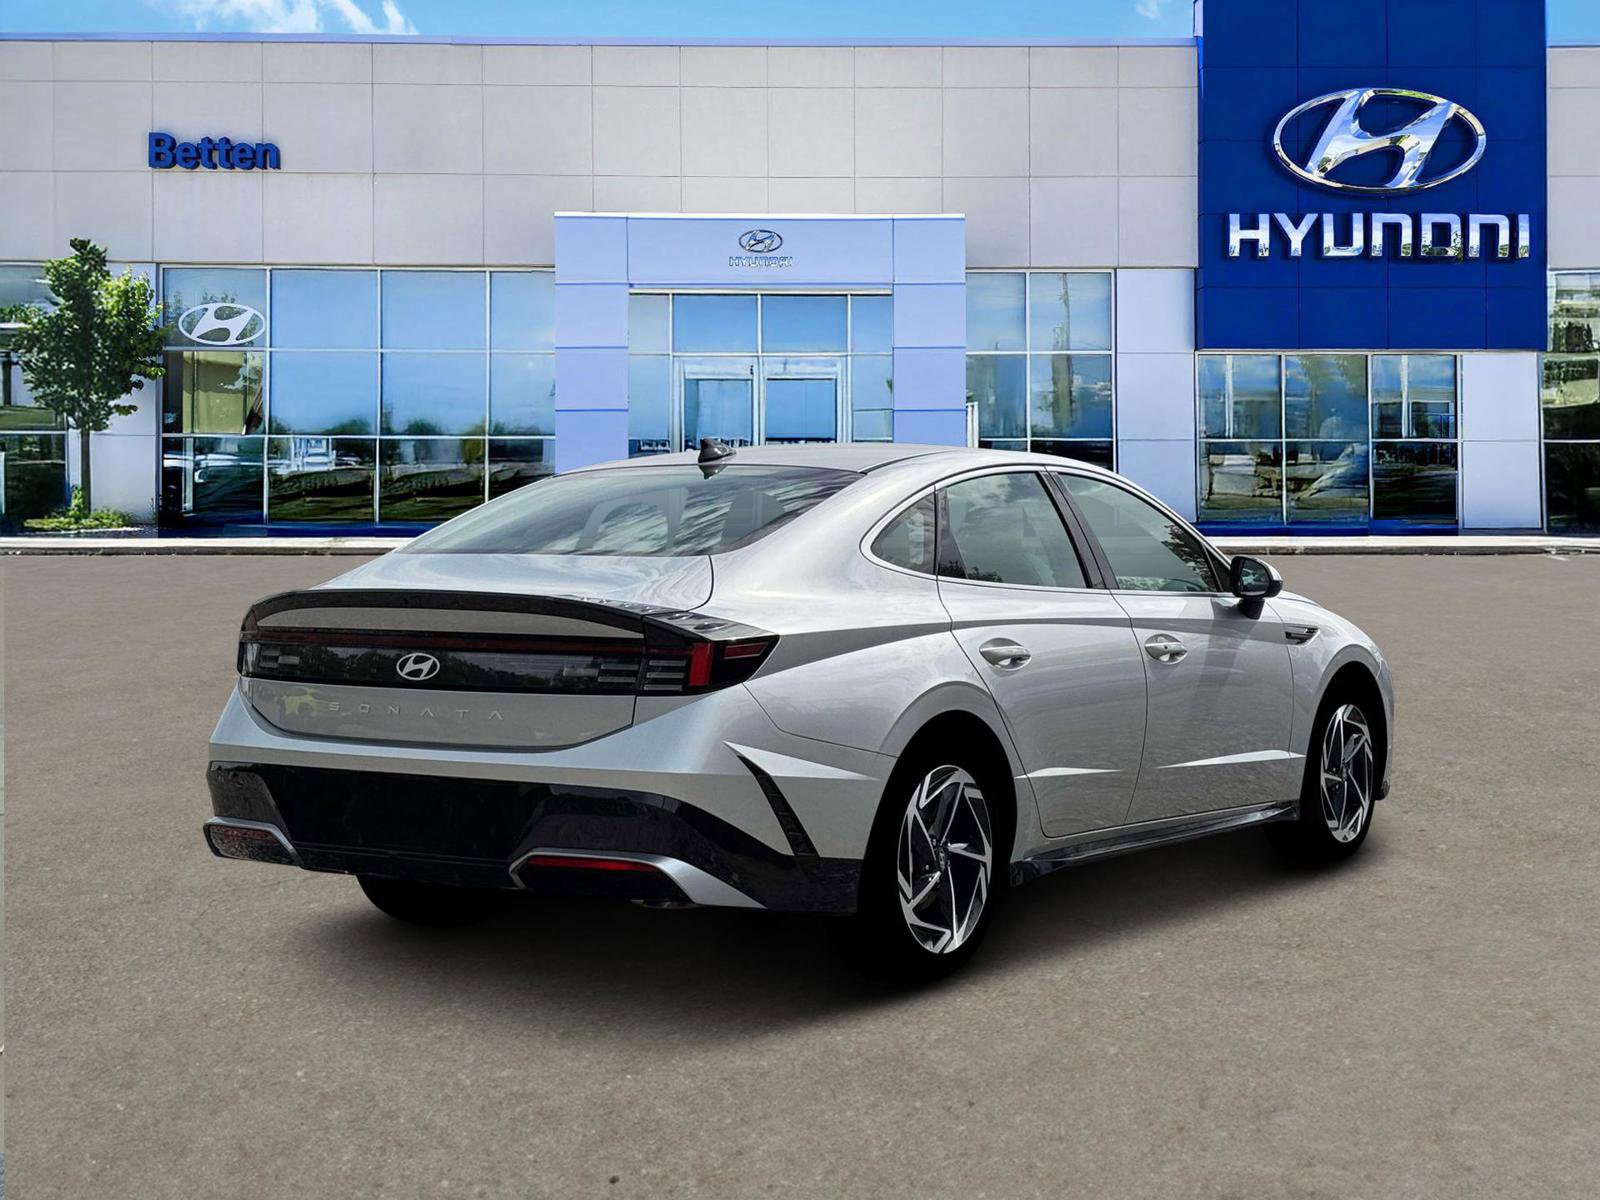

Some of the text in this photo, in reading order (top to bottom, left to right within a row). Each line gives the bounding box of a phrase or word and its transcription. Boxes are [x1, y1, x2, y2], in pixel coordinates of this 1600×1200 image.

[148, 132, 281, 170] Betten
[1228, 213, 1530, 259] HYUNDAI
[329, 701, 504, 722] SONATA
